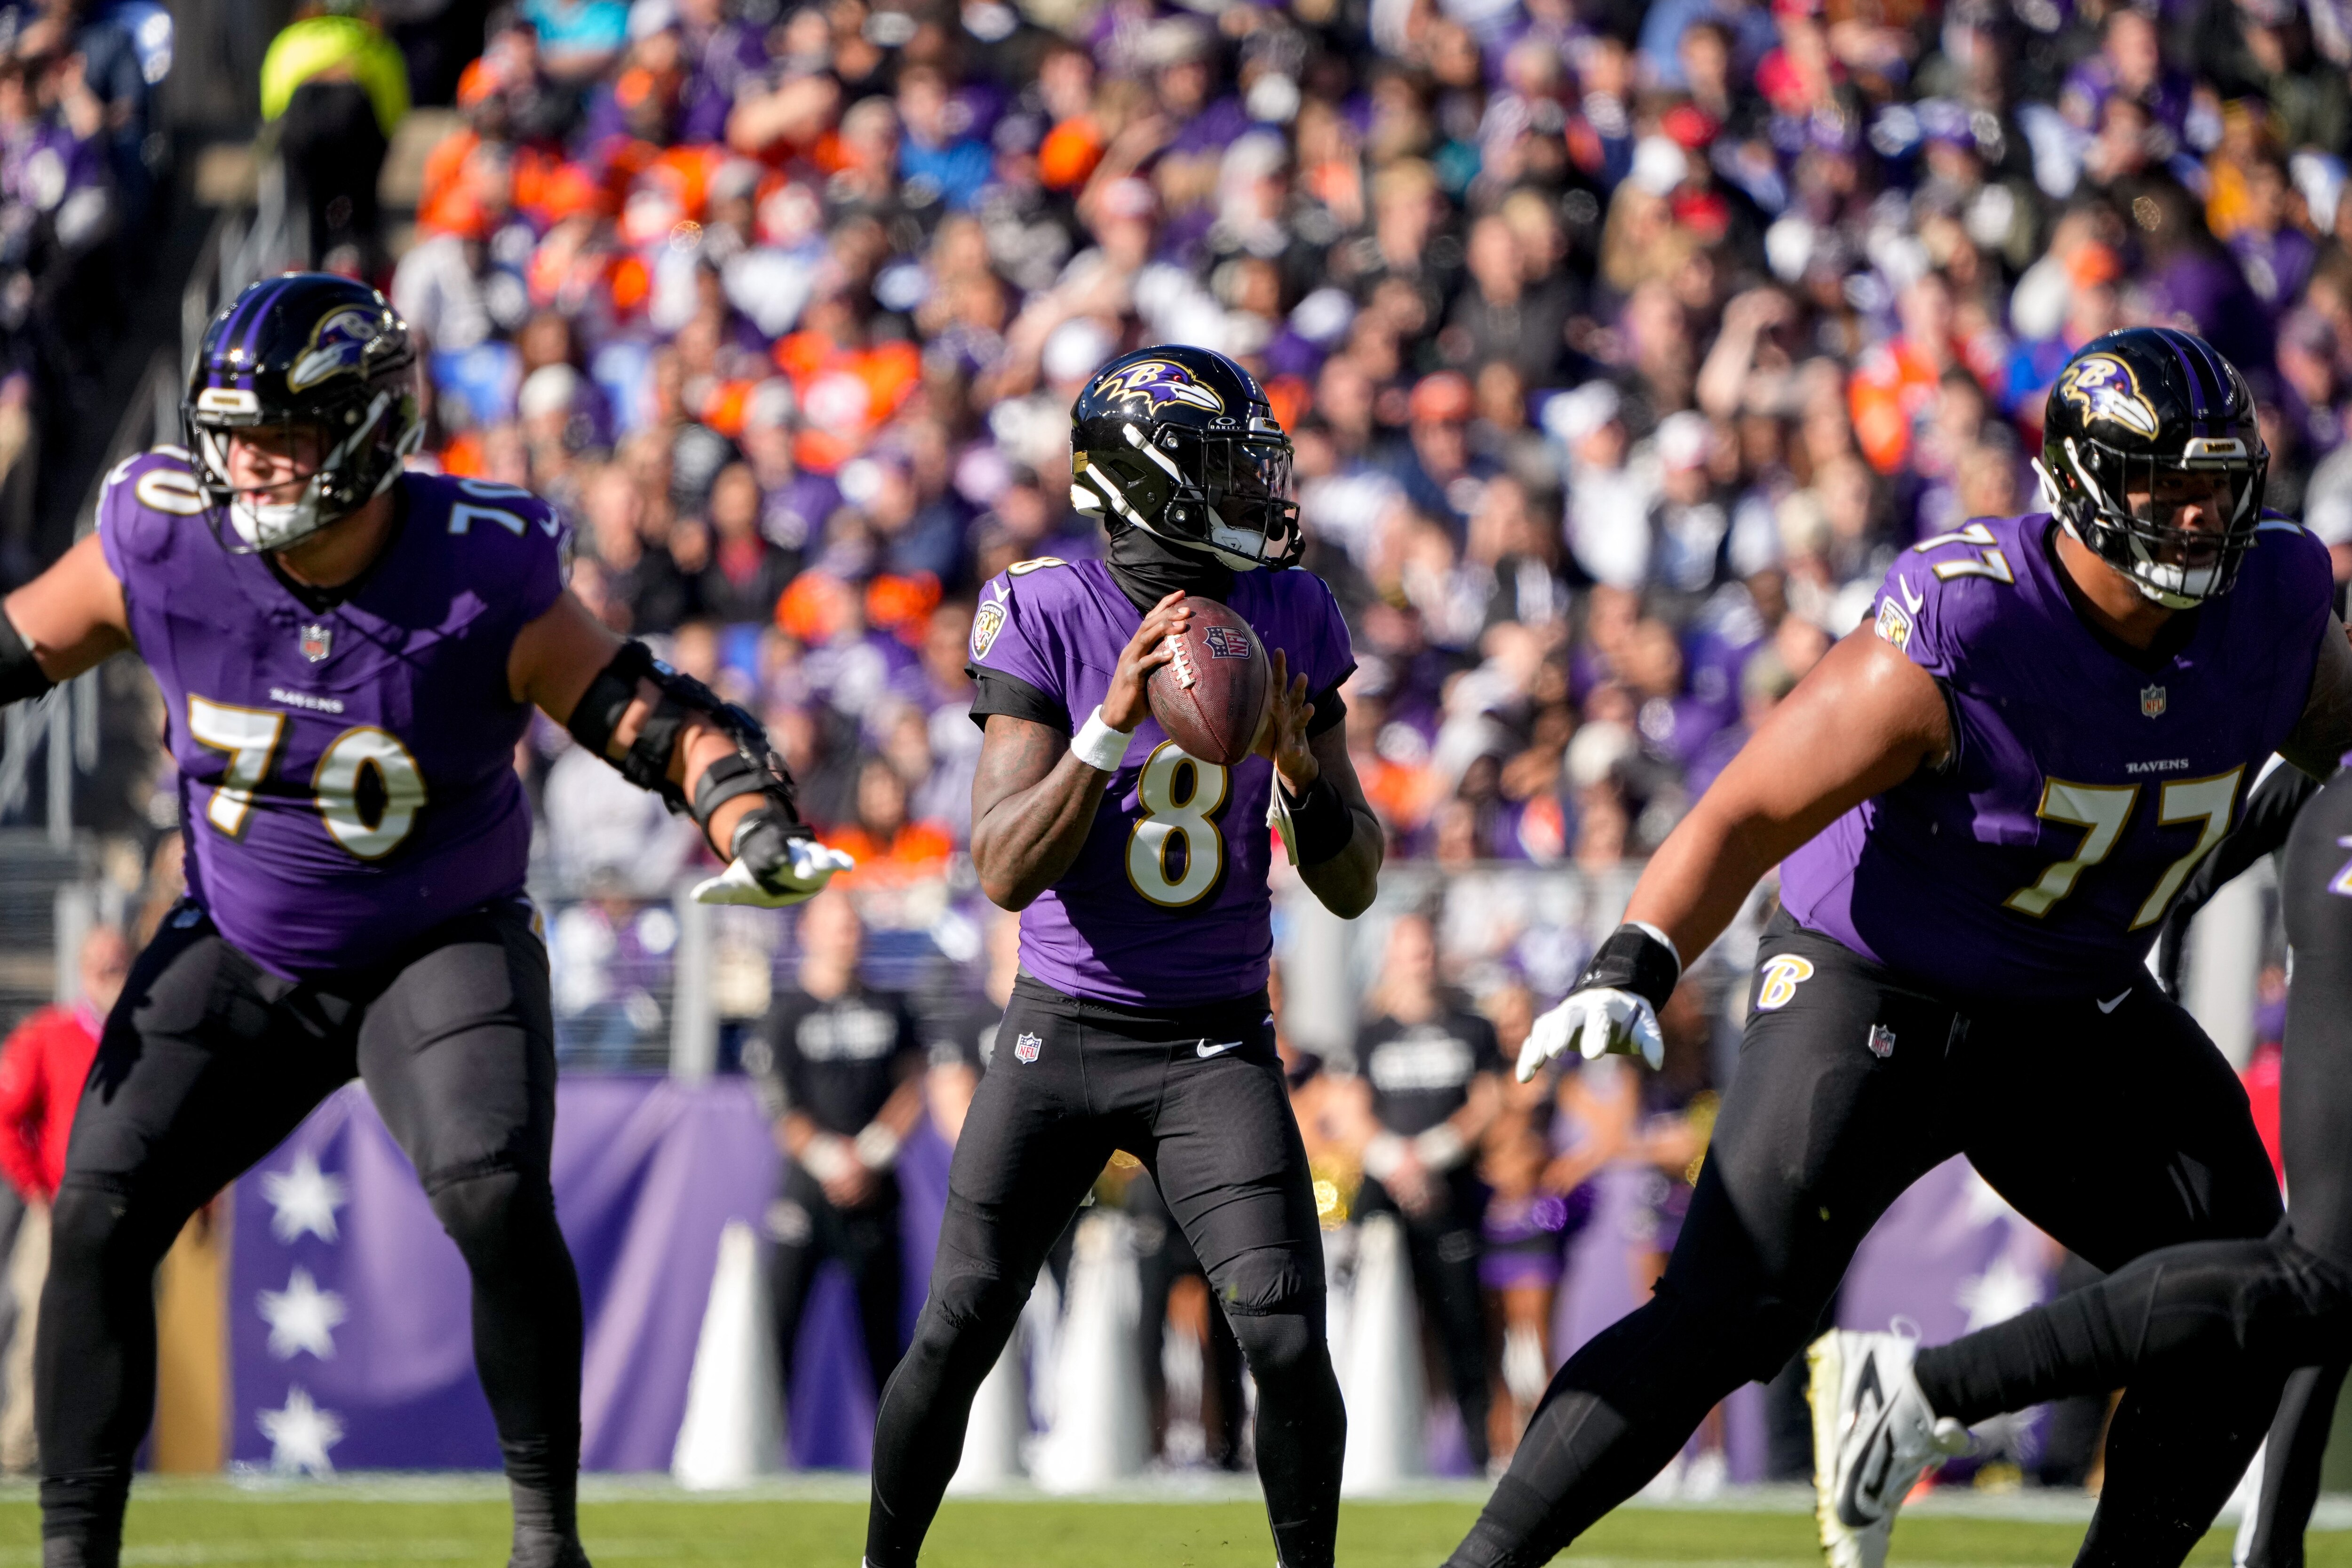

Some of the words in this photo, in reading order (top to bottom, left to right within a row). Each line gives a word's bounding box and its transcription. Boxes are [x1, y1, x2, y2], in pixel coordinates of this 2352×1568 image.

[1121, 363, 1166, 388] B
[1914, 523, 2015, 584] 77
[1008, 557, 1068, 577] 8
[981, 605, 1002, 616] RAVENS
[1225, 630, 1248, 656] NFL
[2145, 700, 2162, 713] NFL
[185, 693, 428, 861] 70
[2125, 759, 2189, 774] RAVENS
[1126, 739, 1228, 908] 8
[2002, 763, 2246, 931] 77
[1757, 953, 1814, 1010] B
[1019, 1045, 1035, 1058] NFL
[1874, 1038, 1889, 1052] NFL
